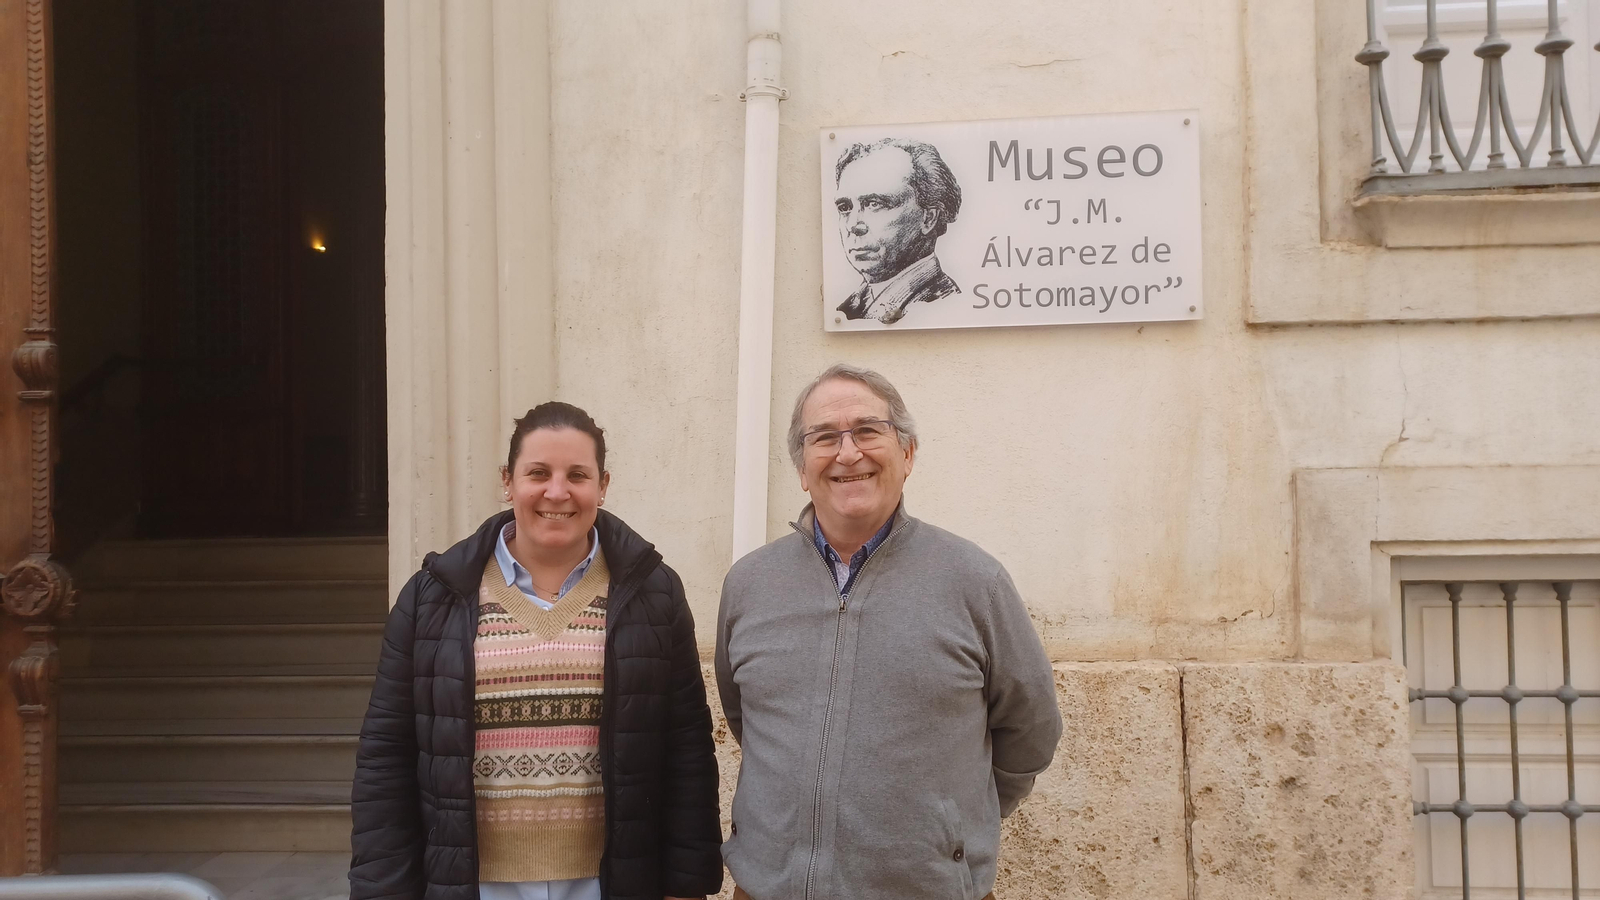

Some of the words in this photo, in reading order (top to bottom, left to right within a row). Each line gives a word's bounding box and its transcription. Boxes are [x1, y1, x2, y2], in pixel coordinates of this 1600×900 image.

[987, 139, 1165, 183] Museo
[980, 234, 1119, 268] Álvarez
[1131, 235, 1173, 264] de
